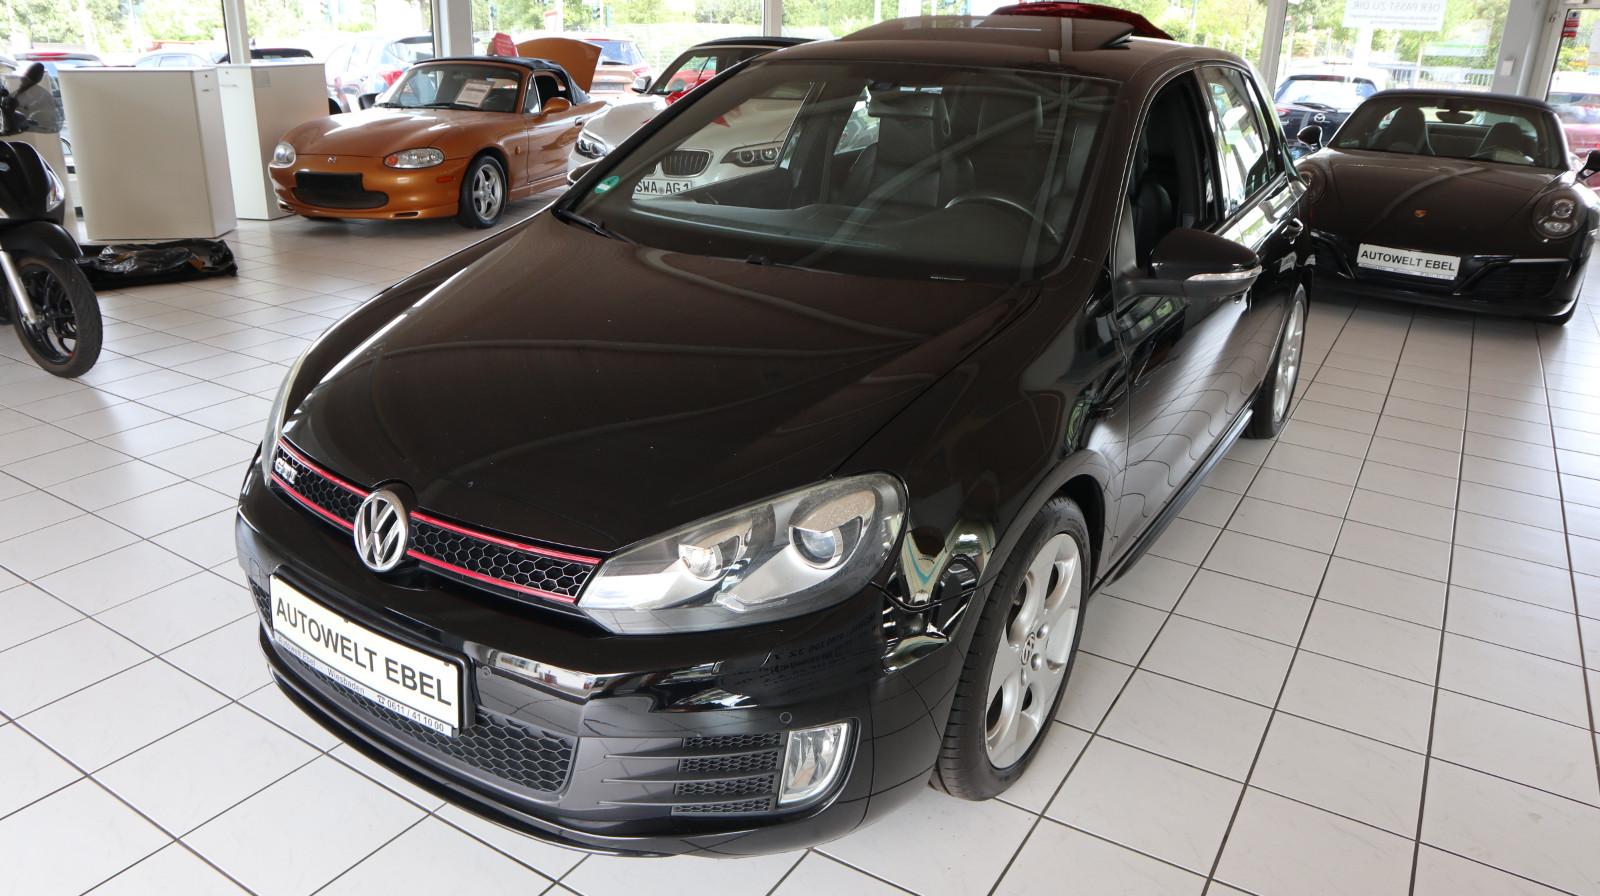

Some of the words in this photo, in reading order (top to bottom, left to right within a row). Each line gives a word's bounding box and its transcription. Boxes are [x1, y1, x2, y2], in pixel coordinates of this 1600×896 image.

[1361, 250, 1423, 267] AUTOWELT
[1424, 259, 1456, 271] EBEL
[276, 597, 378, 673] AUTOWELT
[384, 656, 452, 706] EBEL
[327, 668, 365, 694] Wiesbaden
[387, 700, 405, 712] 0611
